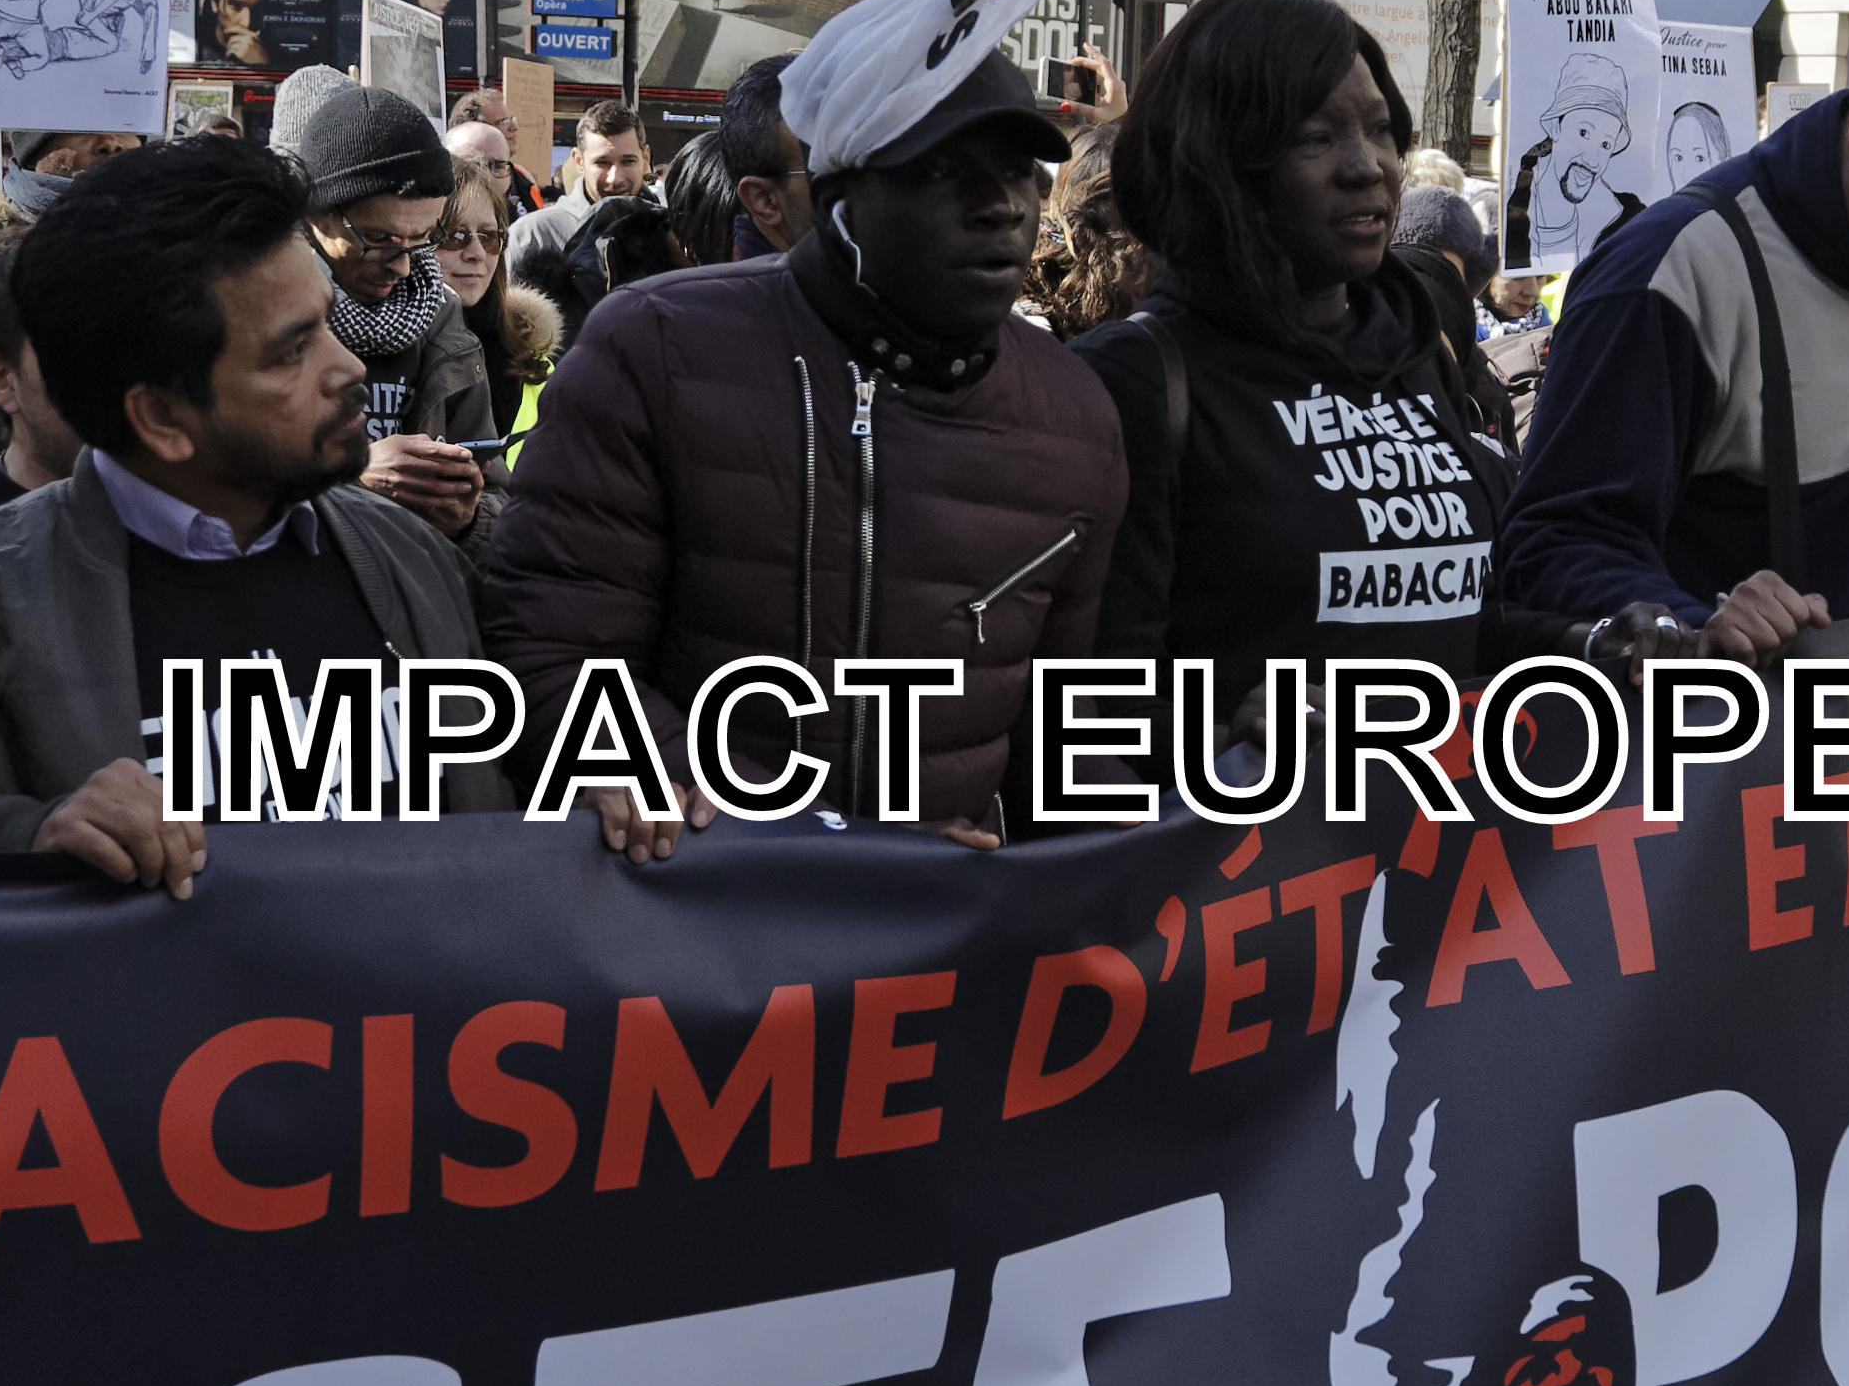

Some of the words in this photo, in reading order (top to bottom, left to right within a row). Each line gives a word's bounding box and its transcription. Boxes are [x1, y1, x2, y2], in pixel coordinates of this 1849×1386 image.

[537, 32, 612, 51] OUVERT
[1567, 19, 1616, 43] TANDIA
[1660, 26, 1703, 49] Justice
[1705, 41, 1727, 54] pour
[1662, 54, 1687, 74] TINA
[1692, 58, 1727, 78] SEBAA
[1313, 440, 1473, 492] JUSTICE
[1356, 491, 1474, 544] POUR
